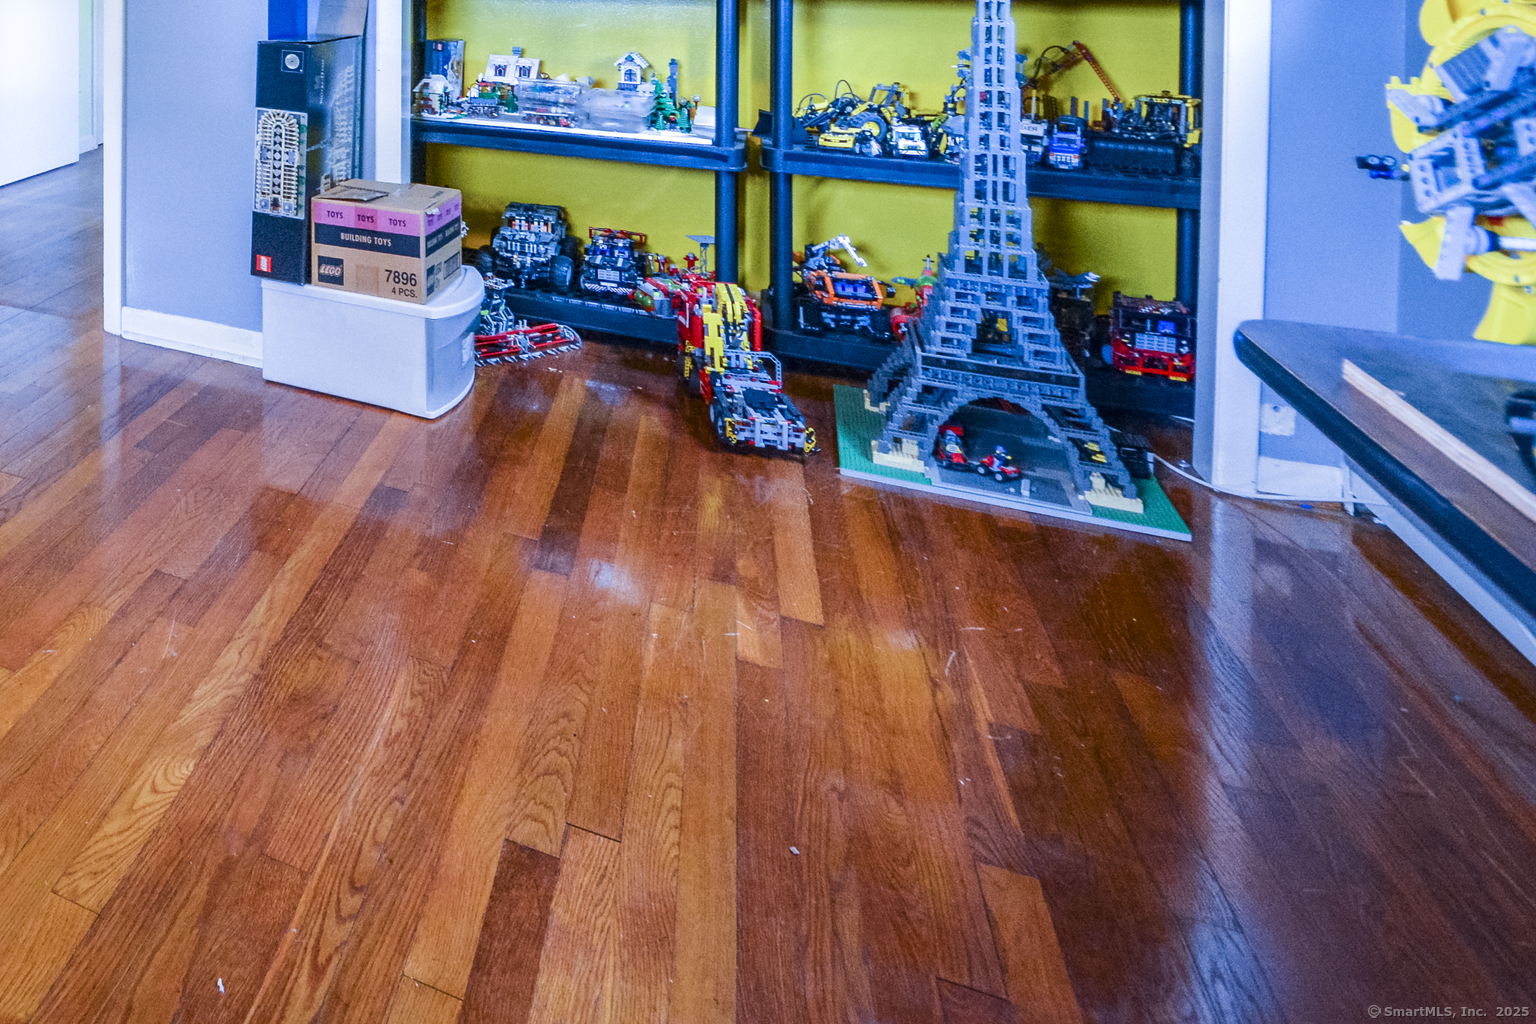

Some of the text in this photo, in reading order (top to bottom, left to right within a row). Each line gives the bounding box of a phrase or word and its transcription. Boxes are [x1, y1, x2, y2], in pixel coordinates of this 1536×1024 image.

[326, 210, 407, 228] TOYS TOYS TOYS
[340, 232, 392, 247] BUILDING TOYS
[319, 263, 343, 276] LEGO
[384, 269, 417, 287] 7896
[391, 287, 418, 299] 4 PCS.
